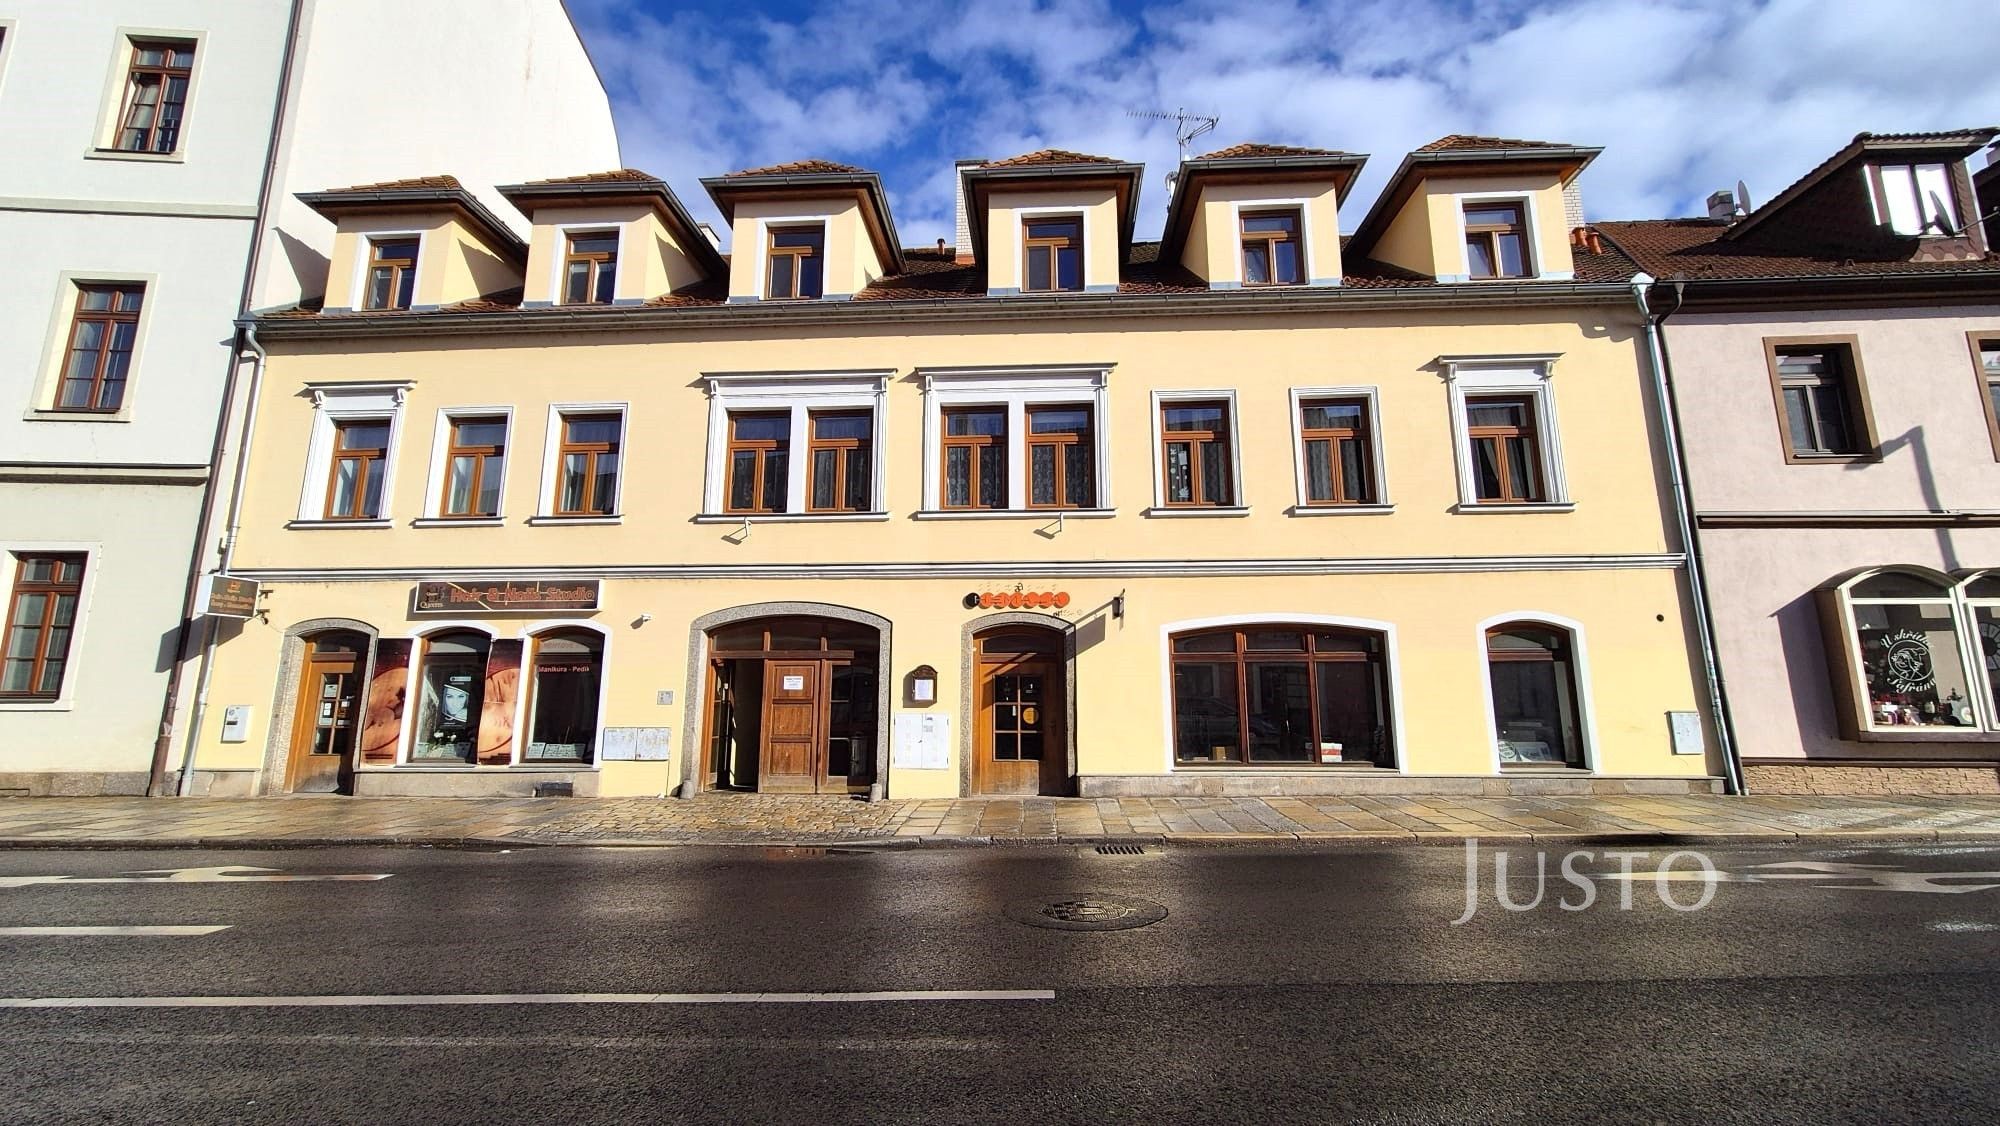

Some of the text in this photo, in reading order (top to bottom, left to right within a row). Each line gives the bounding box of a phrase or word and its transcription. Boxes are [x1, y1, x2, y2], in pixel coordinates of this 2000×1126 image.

[450, 586, 595, 602] Hair & Nails Studio
